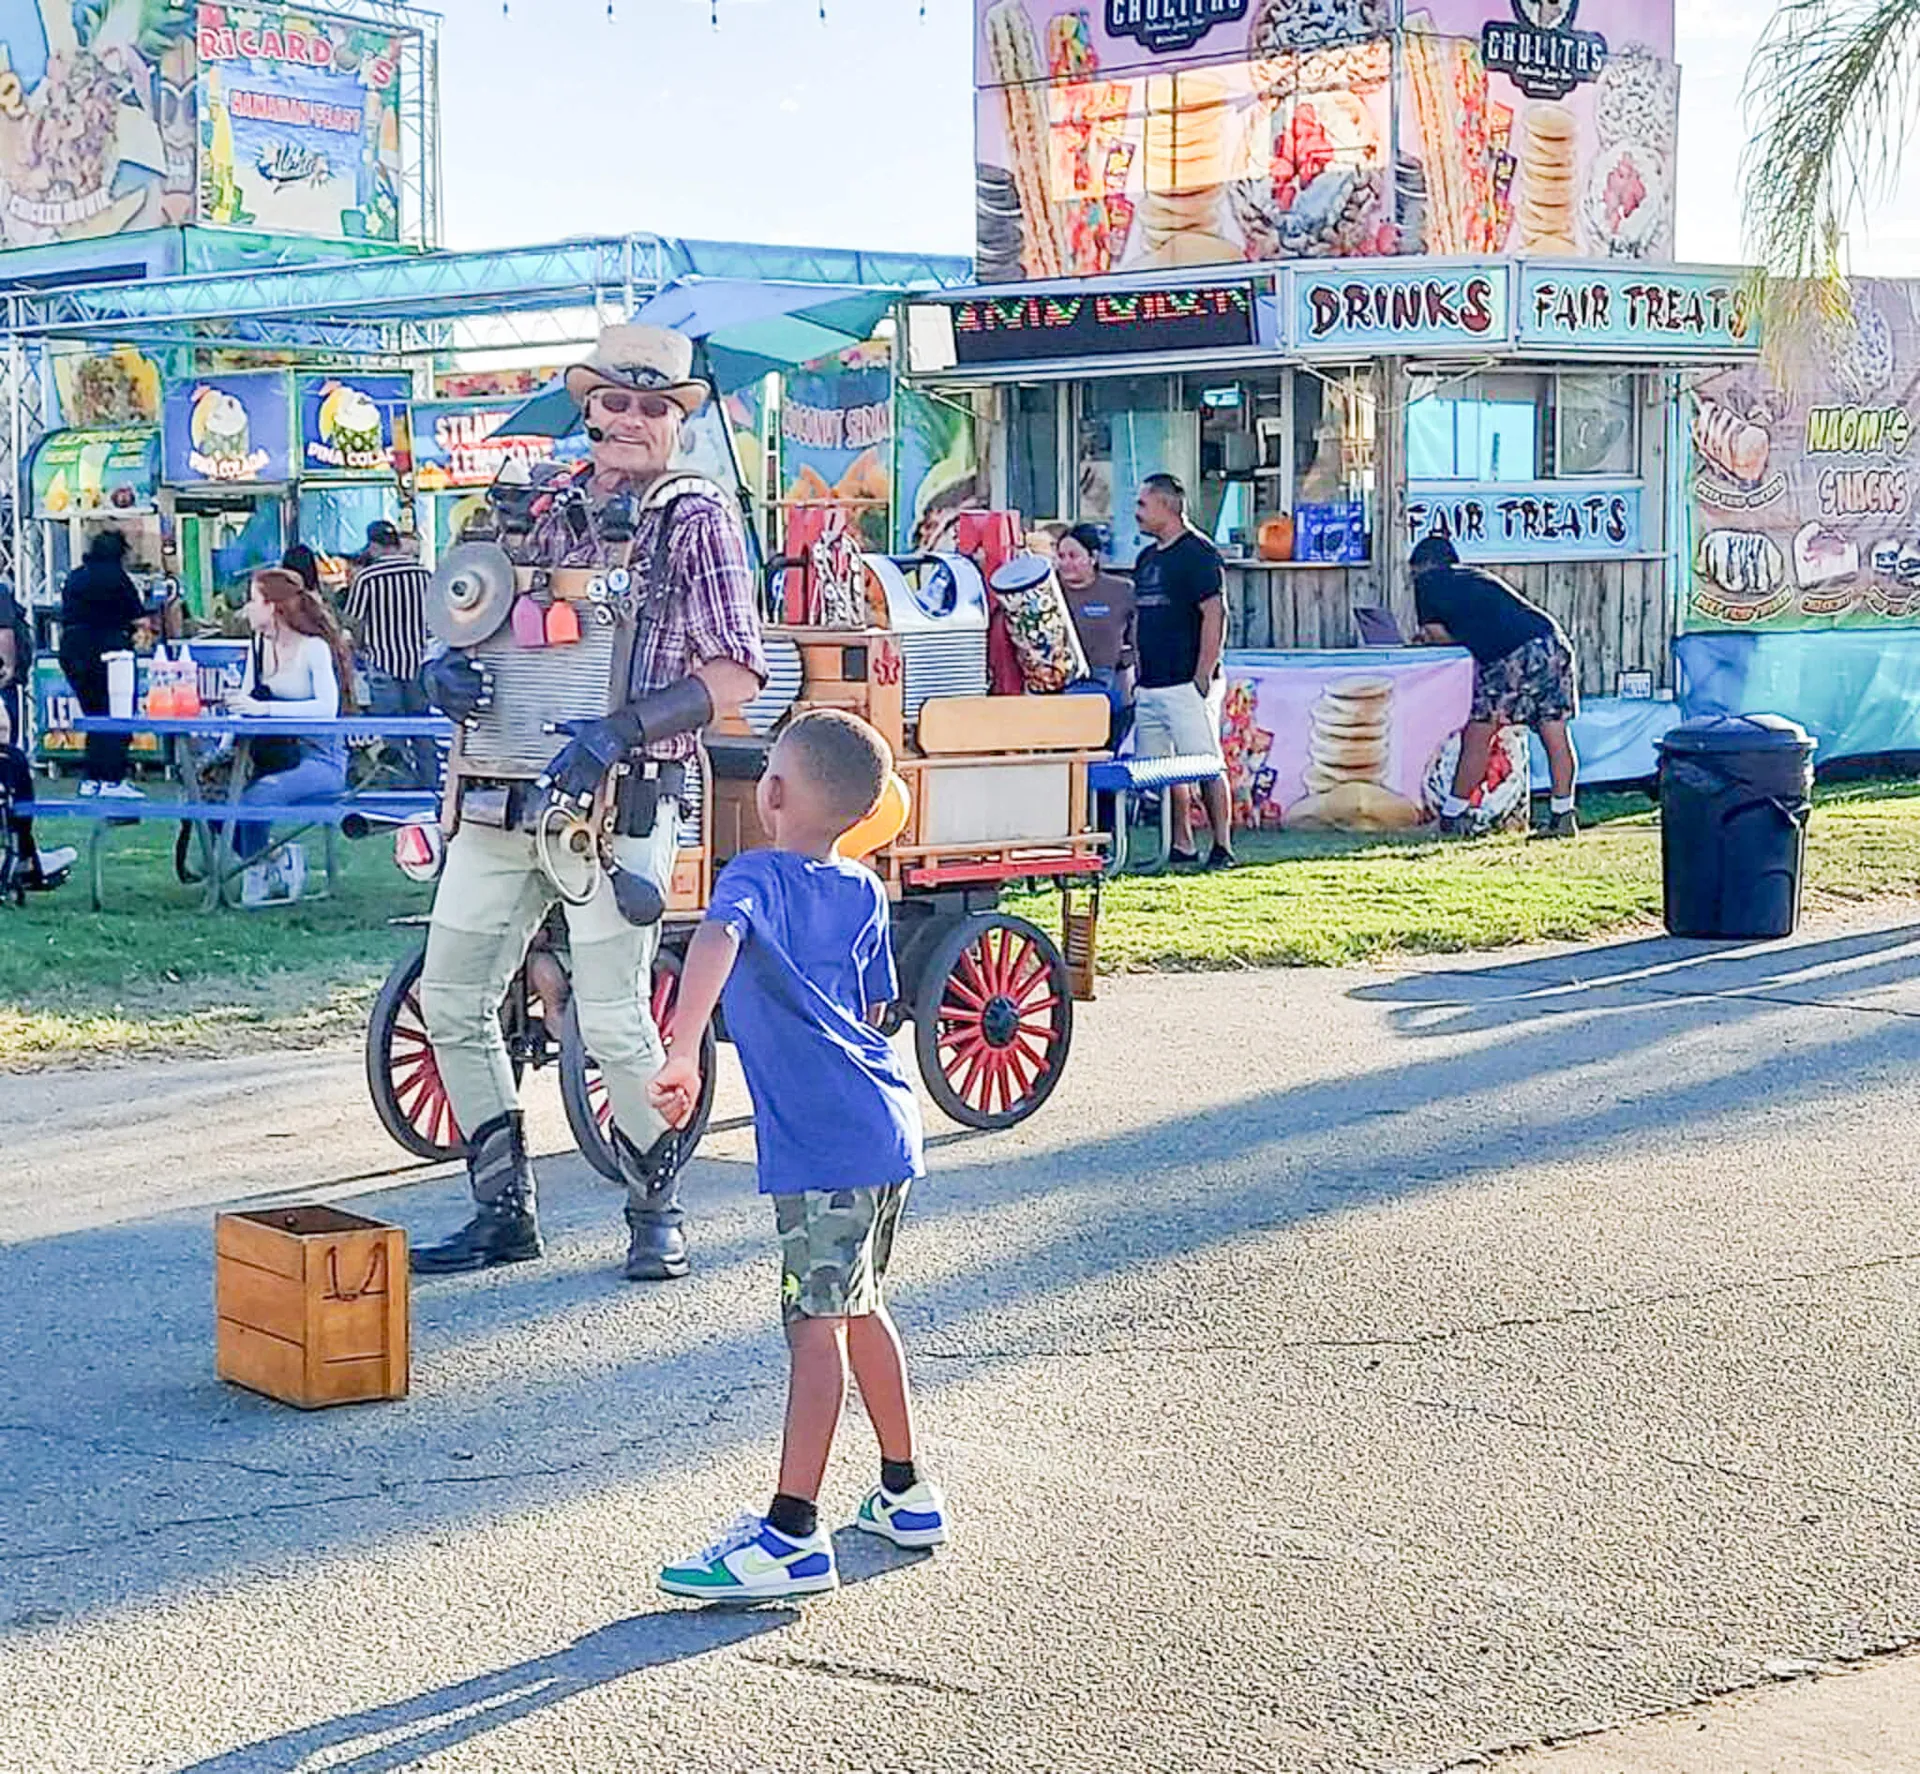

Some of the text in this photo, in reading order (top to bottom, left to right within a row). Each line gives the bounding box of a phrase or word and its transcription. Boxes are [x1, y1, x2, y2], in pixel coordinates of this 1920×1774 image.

[1487, 30, 1603, 72] CHULITAS
[1309, 278, 1493, 336] DRINKS
[1535, 283, 1748, 339] FAIR TREATS
[1806, 406, 1909, 455] NAOMI'S
[1407, 497, 1626, 544] FAIR TREATS
